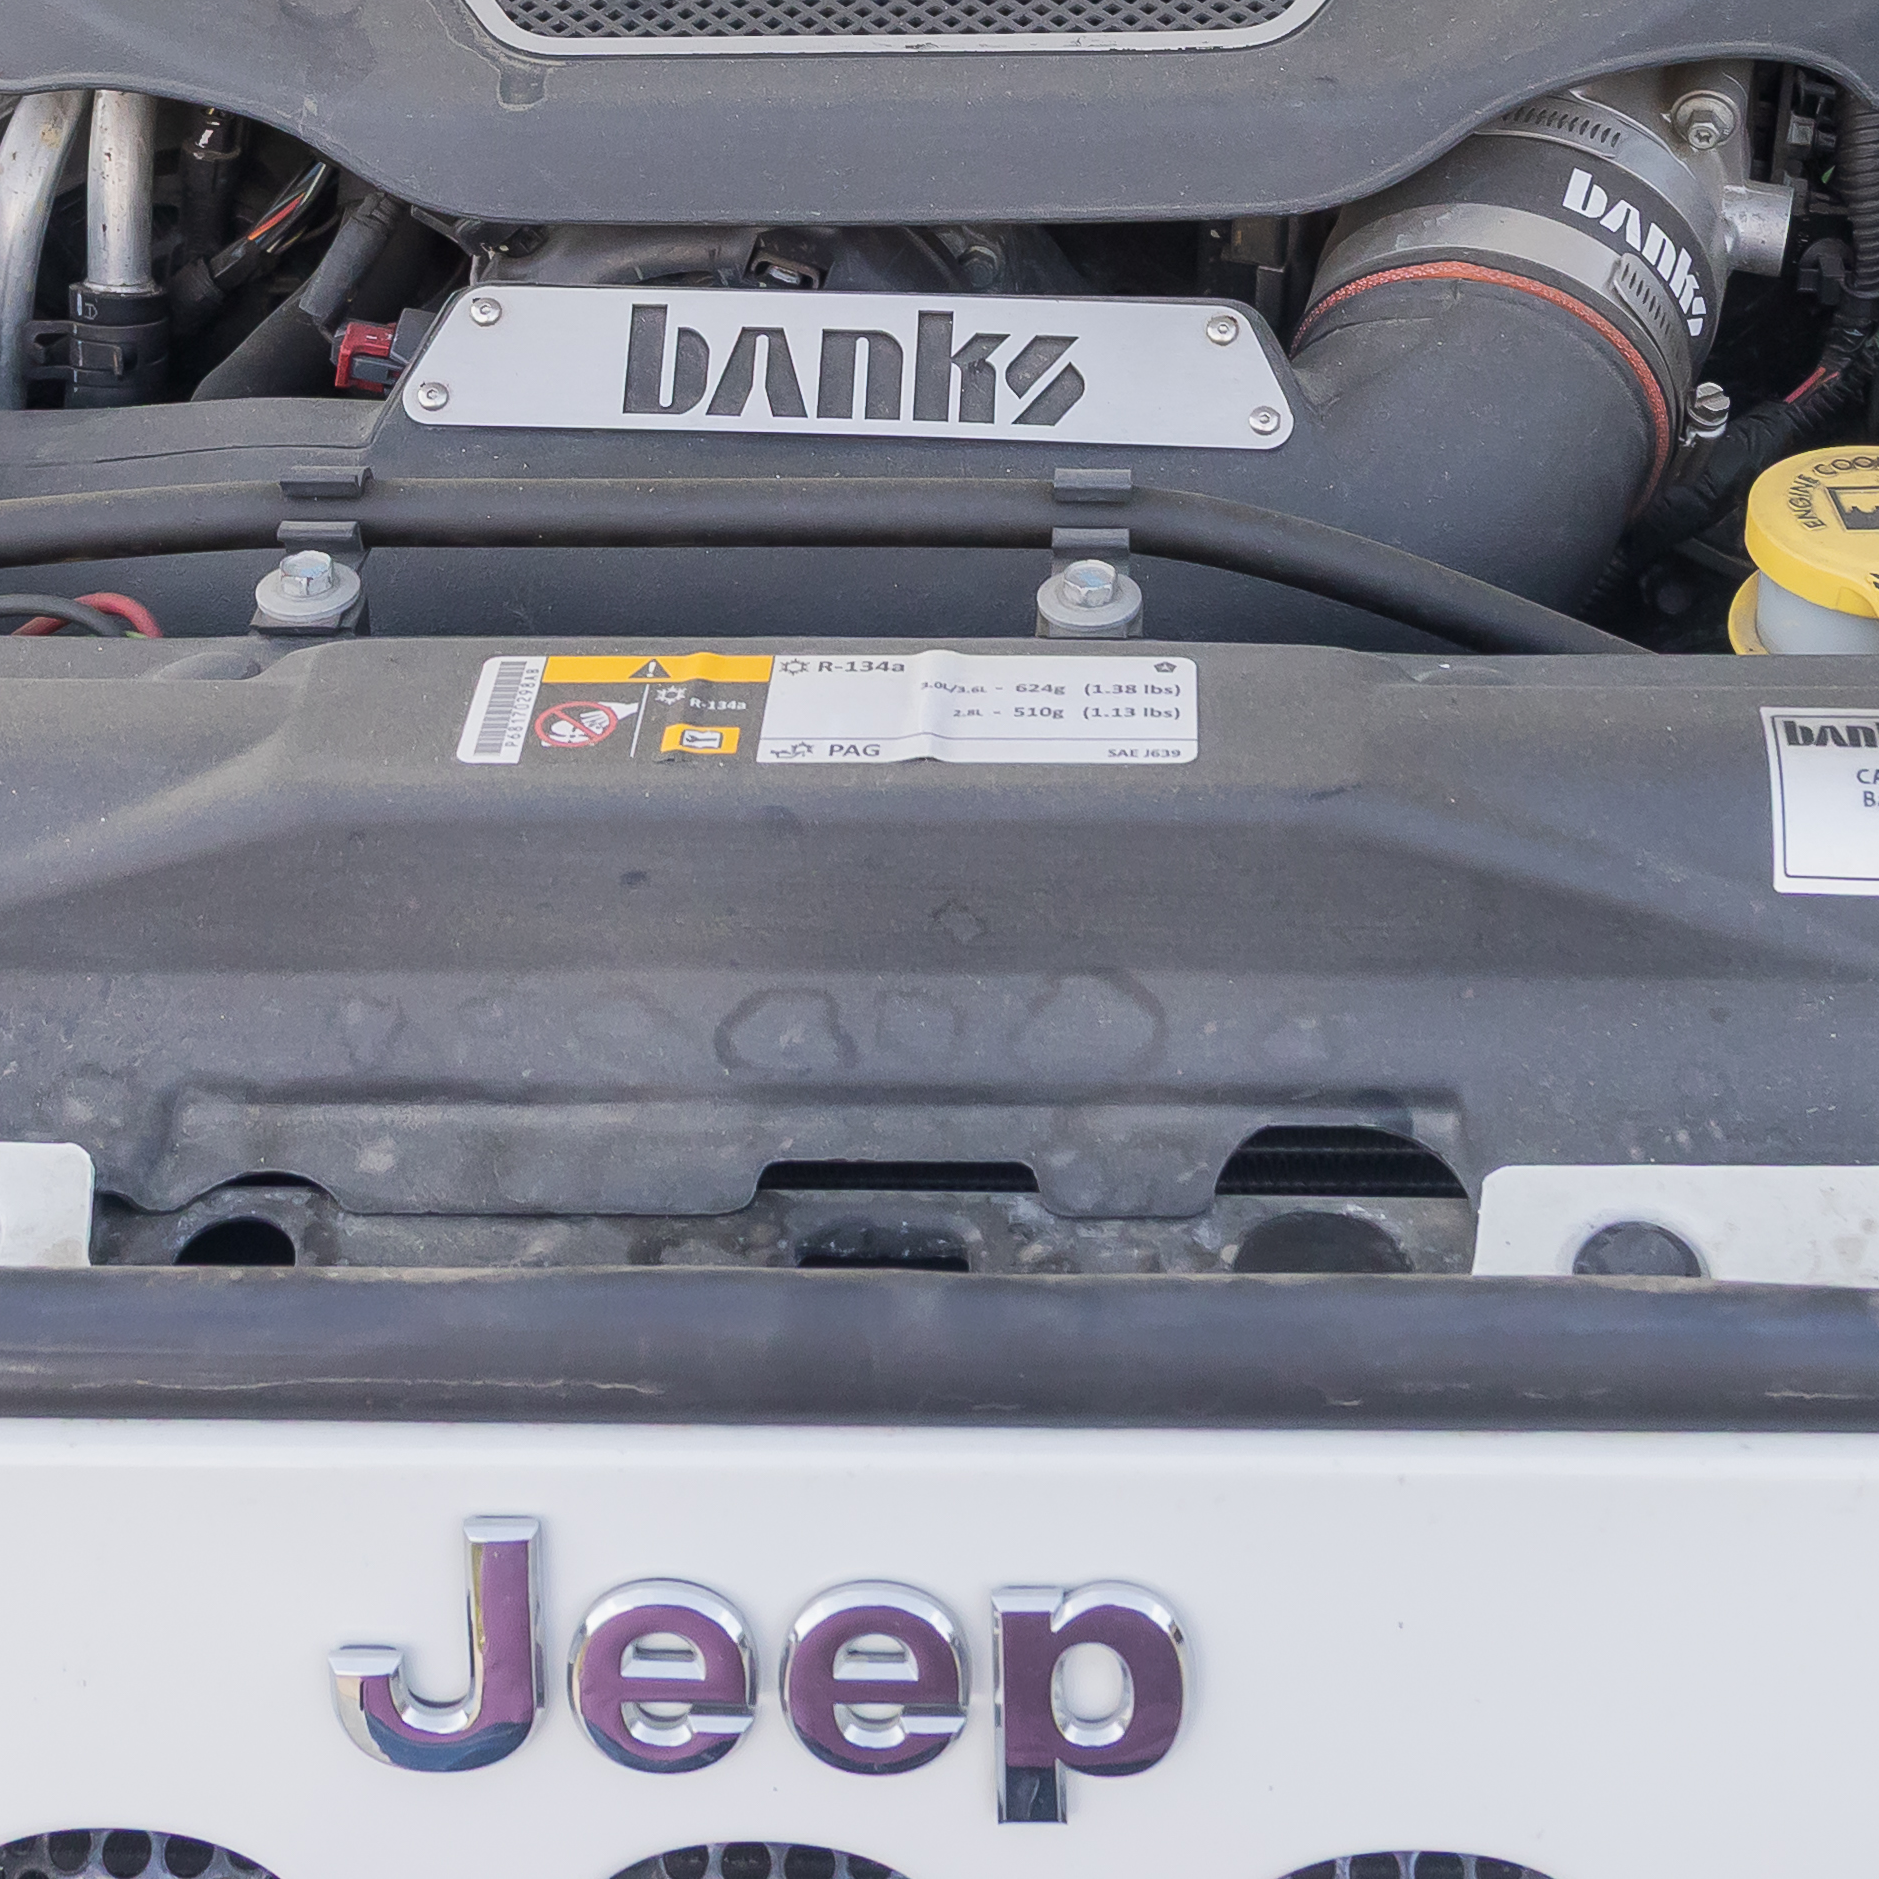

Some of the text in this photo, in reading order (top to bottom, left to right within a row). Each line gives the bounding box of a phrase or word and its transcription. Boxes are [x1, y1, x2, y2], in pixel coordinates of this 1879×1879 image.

[622, 303, 1087, 426] banks
[1788, 473, 1827, 531] ENGINE
[818, 658, 906, 676] R-134a
[1014, 683, 1067, 697] 624g
[1083, 682, 1138, 698] (1.38
[1143, 681, 1183, 698] lbs)
[505, 668, 540, 748] P68170298AB
[689, 697, 748, 720] R-134a
[1014, 705, 1065, 721] 510g
[1081, 705, 1136, 721] (1.13
[1143, 705, 1183, 721] lbs)
[827, 742, 1182, 759] PAG SAE J639
[328, 1514, 1191, 1824] Jeep
